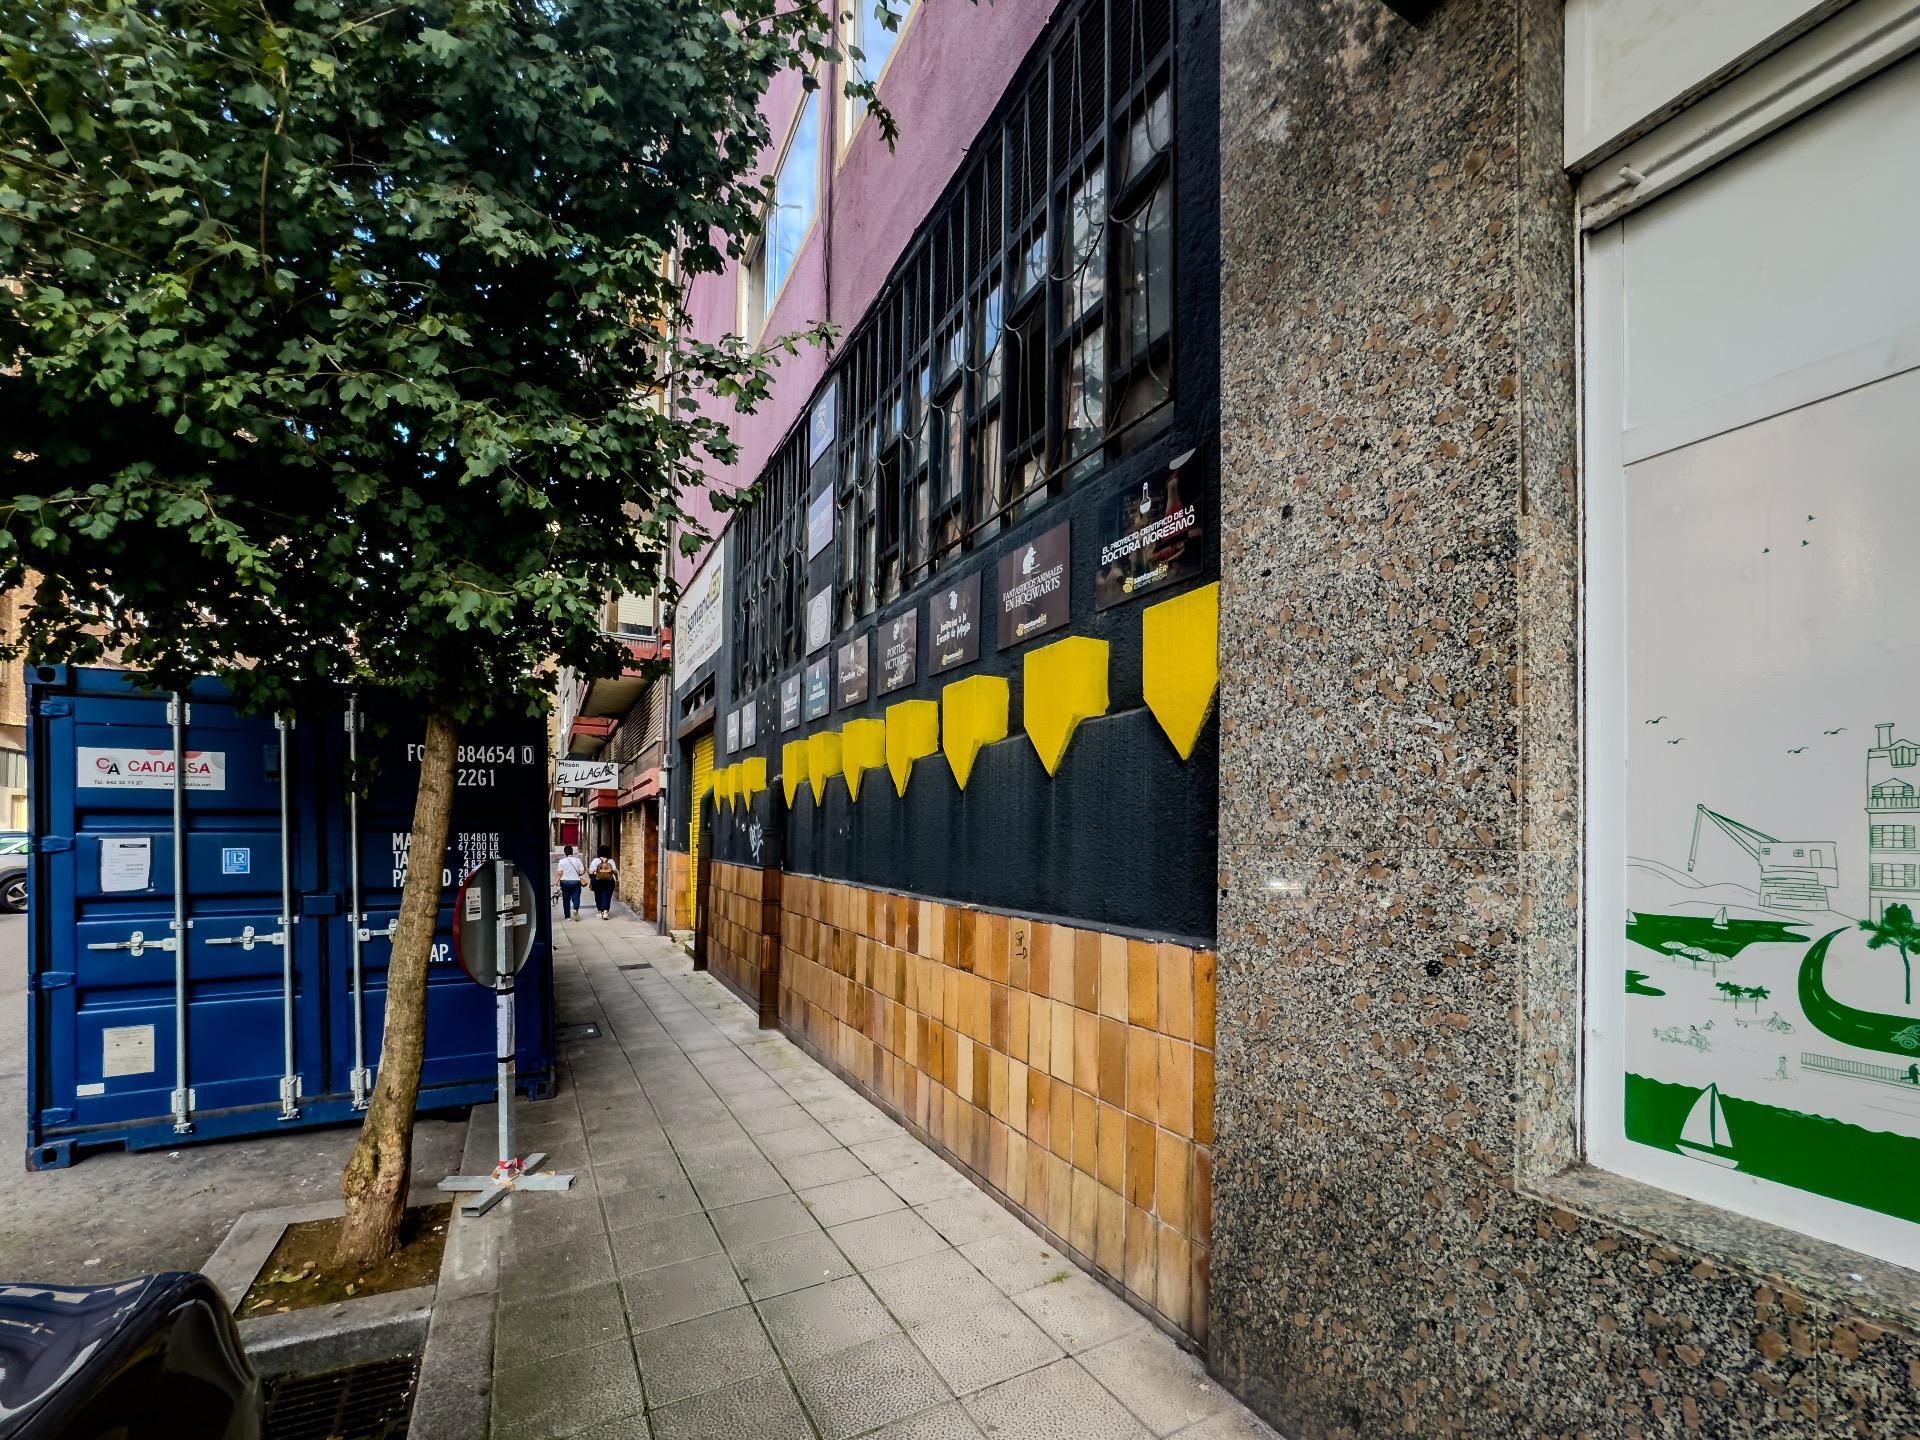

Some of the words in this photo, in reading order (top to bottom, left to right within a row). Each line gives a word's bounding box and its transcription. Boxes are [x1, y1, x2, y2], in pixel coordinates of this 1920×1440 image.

[1102, 546, 1110, 554] EL
[1110, 531, 1139, 550] PROYECTO
[1174, 509, 1184, 520] DE
[1185, 504, 1195, 515] LA
[1101, 540, 1141, 566] DOCTORA
[1143, 514, 1195, 546] NORESMO
[1005, 599, 1014, 613] EN
[1014, 575, 1061, 608] HOGWARTS
[457, 745, 516, 764] 884654
[457, 769, 496, 787] 22G1
[556, 773, 570, 786] EL
[574, 763, 617, 782] LLAGAR
[458, 832, 487, 842] 30.480
[489, 832, 499, 842] KG
[458, 841, 487, 851] 67.200
[489, 841, 499, 851] LB
[463, 850, 487, 860] 2.185
[489, 850, 499, 860] KG
